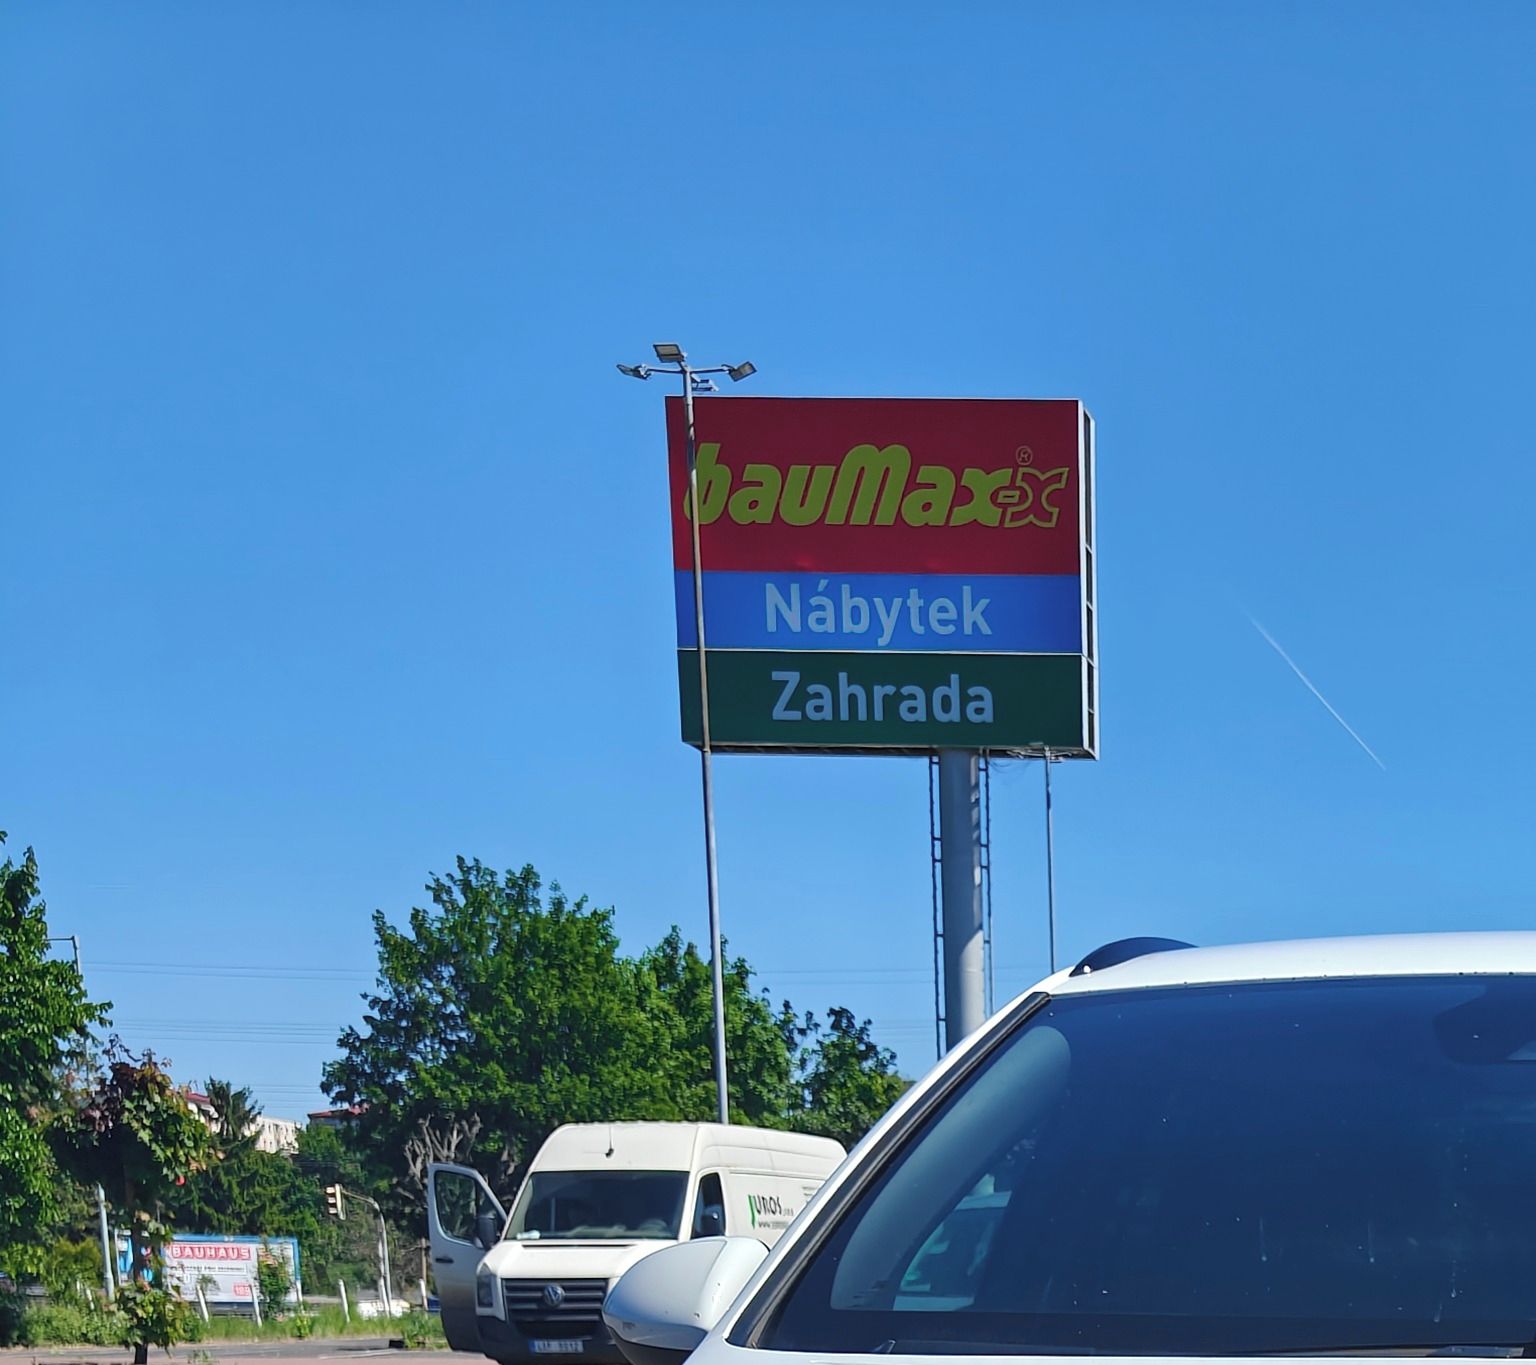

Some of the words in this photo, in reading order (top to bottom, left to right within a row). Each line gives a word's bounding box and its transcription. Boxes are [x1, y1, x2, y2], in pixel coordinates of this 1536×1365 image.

[765, 579, 993, 647] Nábytek
[771, 671, 994, 724] Zahrada
[172, 1246, 250, 1260] BAUHAUS
